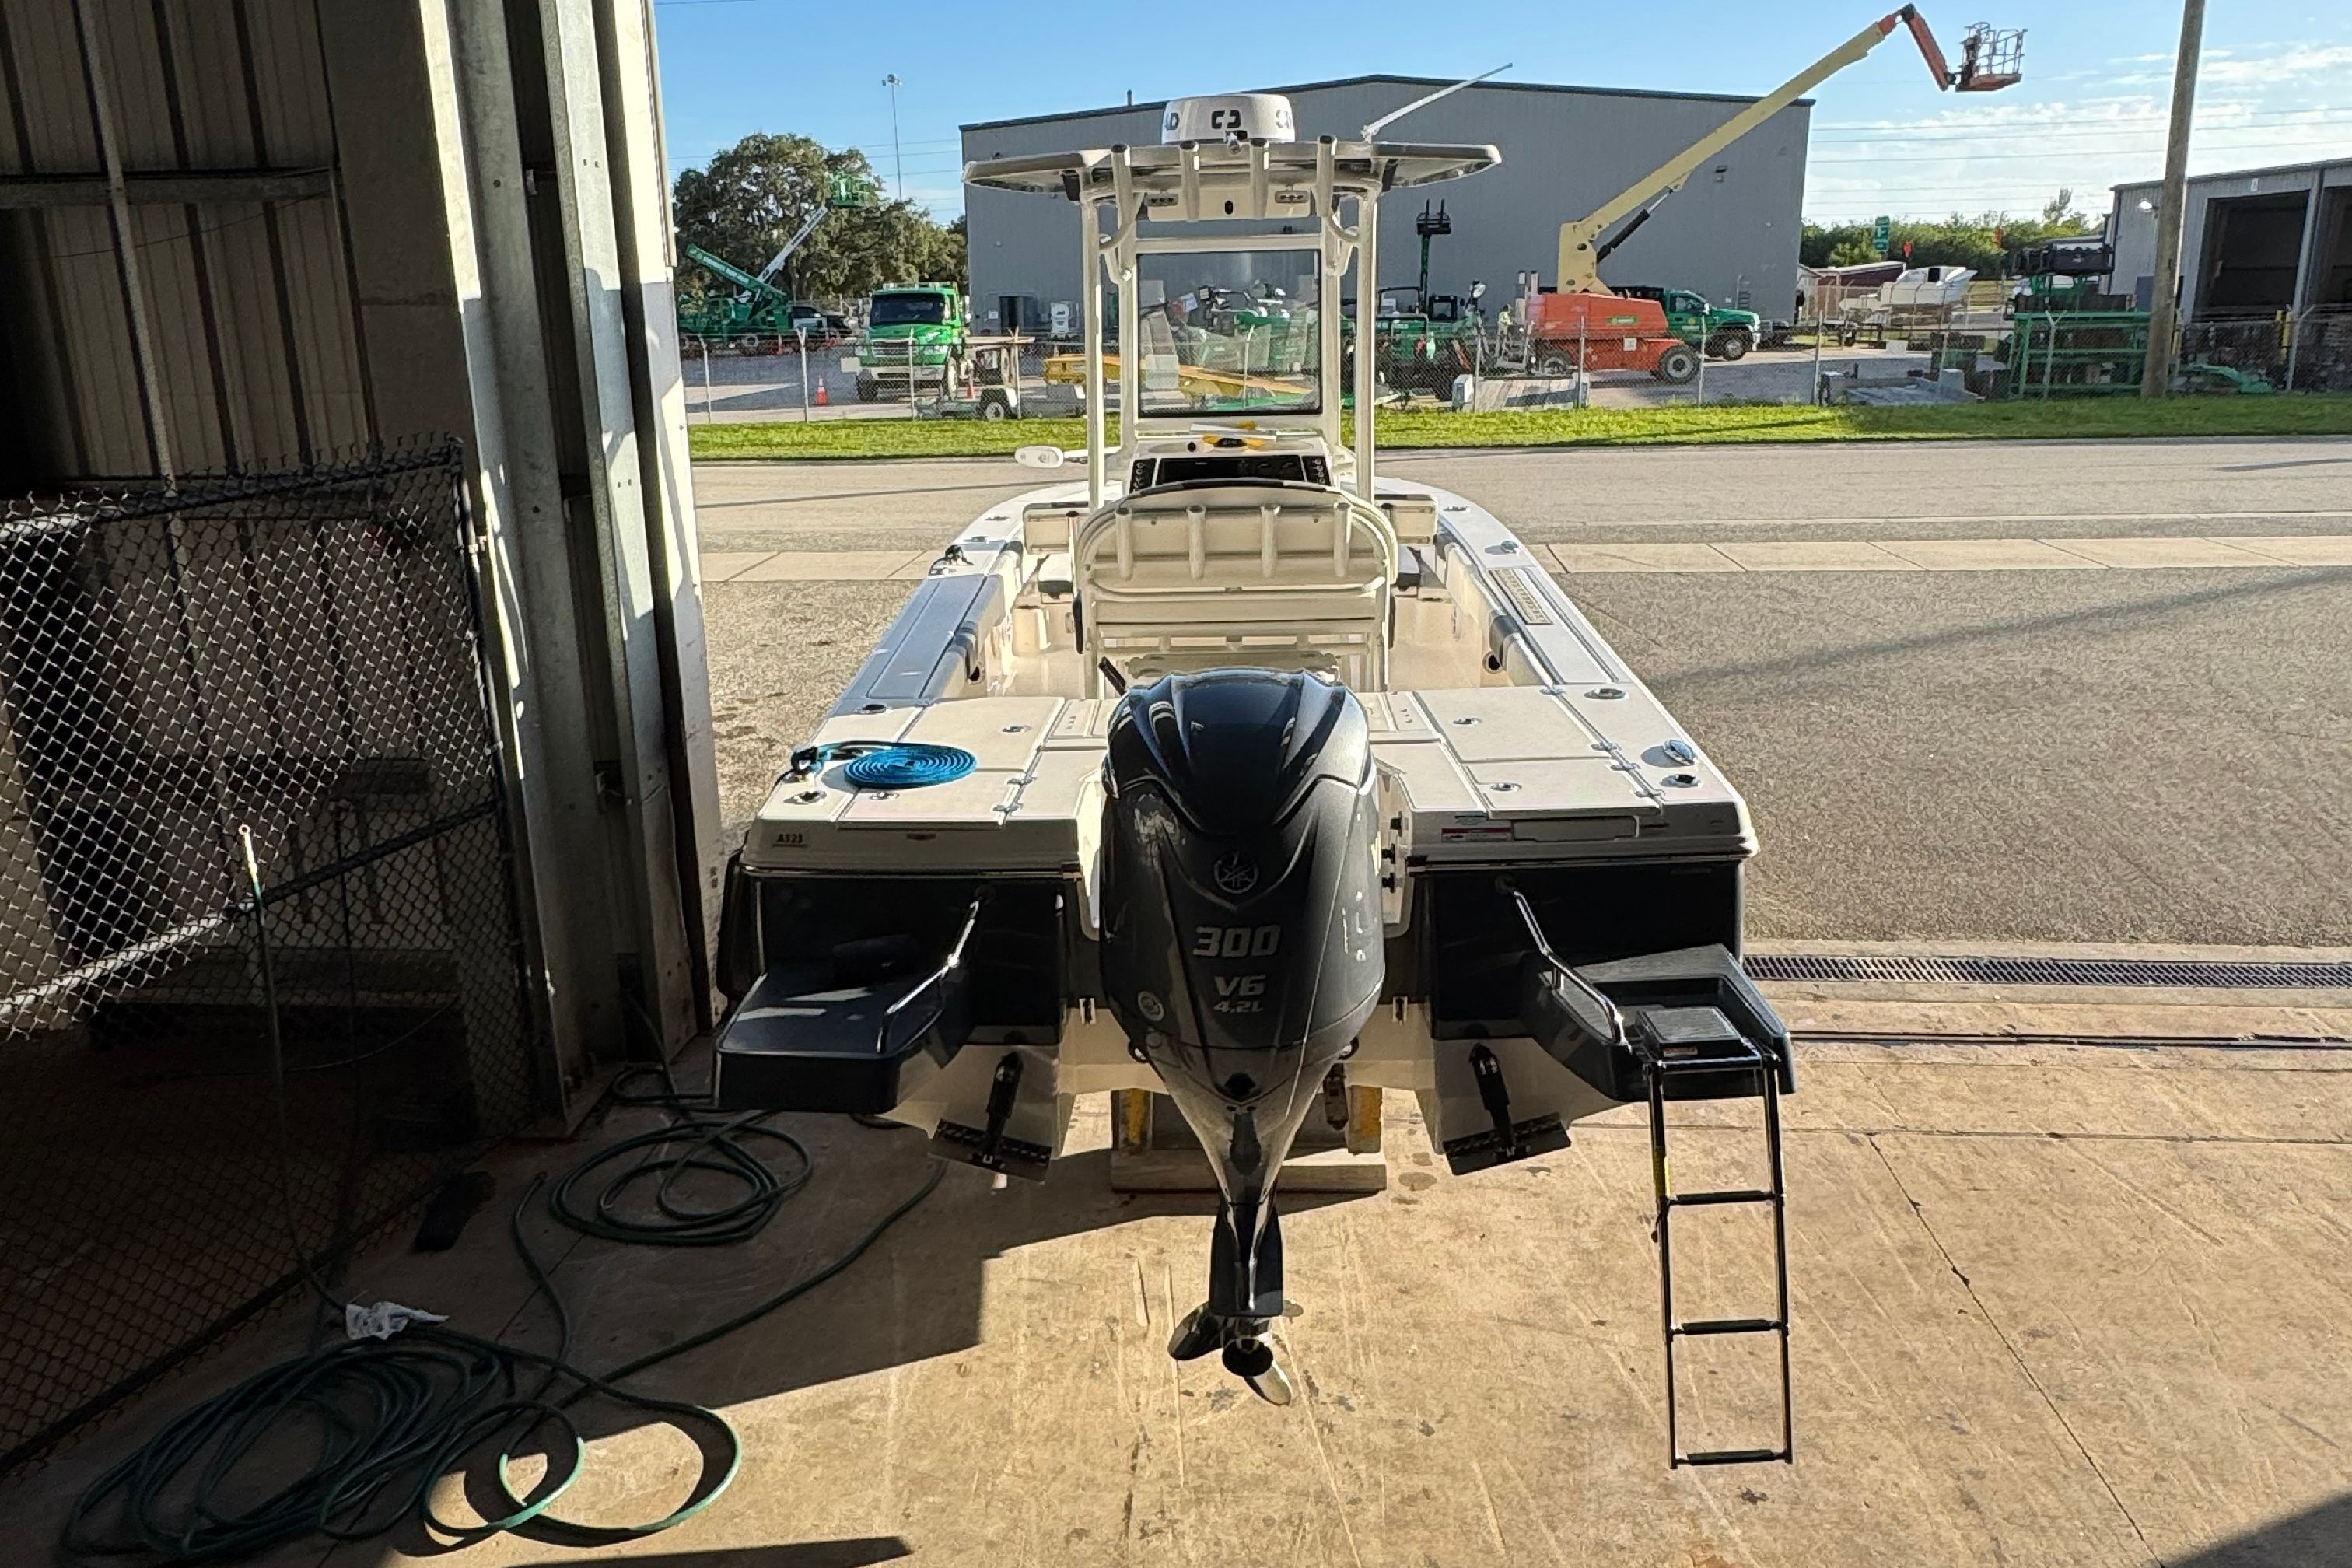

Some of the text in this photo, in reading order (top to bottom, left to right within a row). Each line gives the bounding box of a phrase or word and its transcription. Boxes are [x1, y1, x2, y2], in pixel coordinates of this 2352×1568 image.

[1193, 925, 1281, 957] 300
[1214, 974, 1266, 996] V6
[1213, 1000, 1264, 1013] 4.2L
